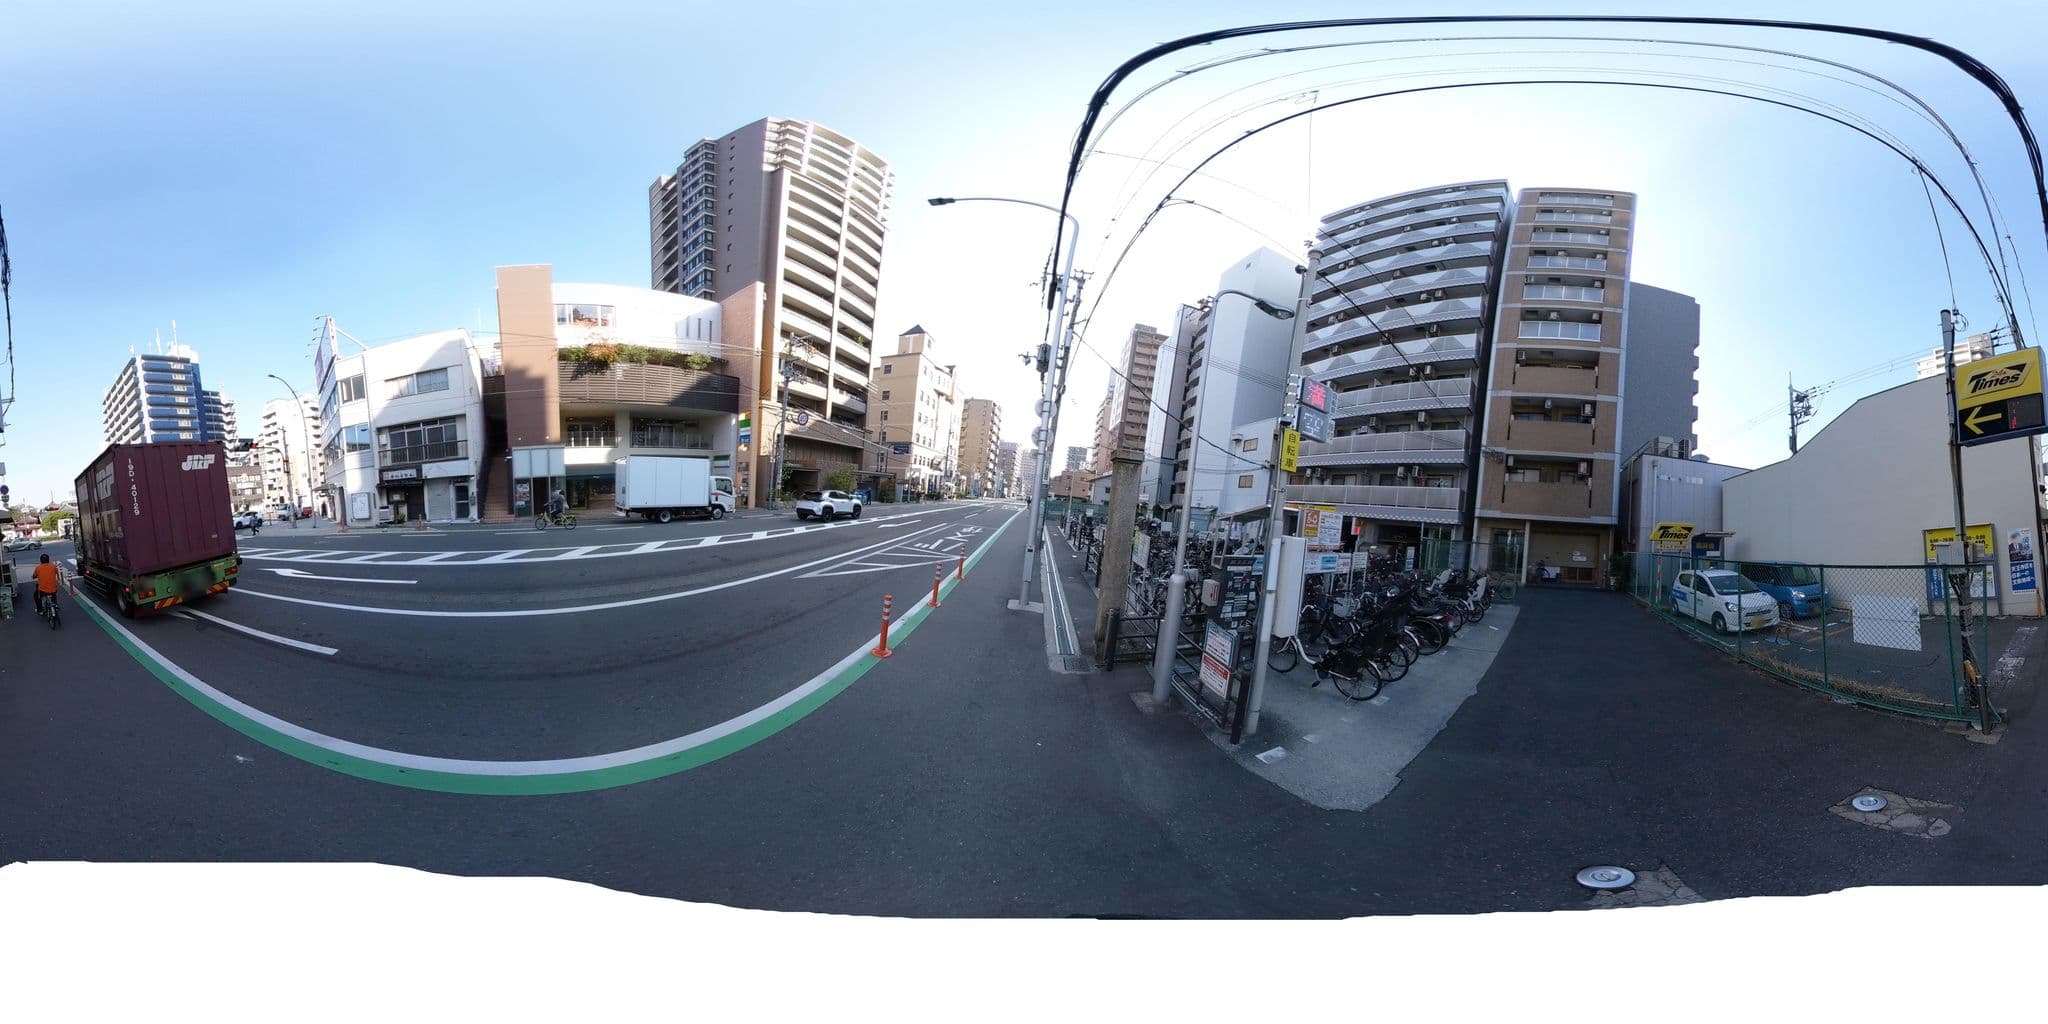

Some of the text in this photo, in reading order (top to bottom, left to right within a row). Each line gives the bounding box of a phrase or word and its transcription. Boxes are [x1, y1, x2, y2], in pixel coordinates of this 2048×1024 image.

[1968, 363, 2027, 394] Times
[1307, 379, 1326, 411] 満
[181, 454, 216, 471] JRF
[1284, 432, 1297, 468] 自転車
[1659, 526, 1694, 539] Times
